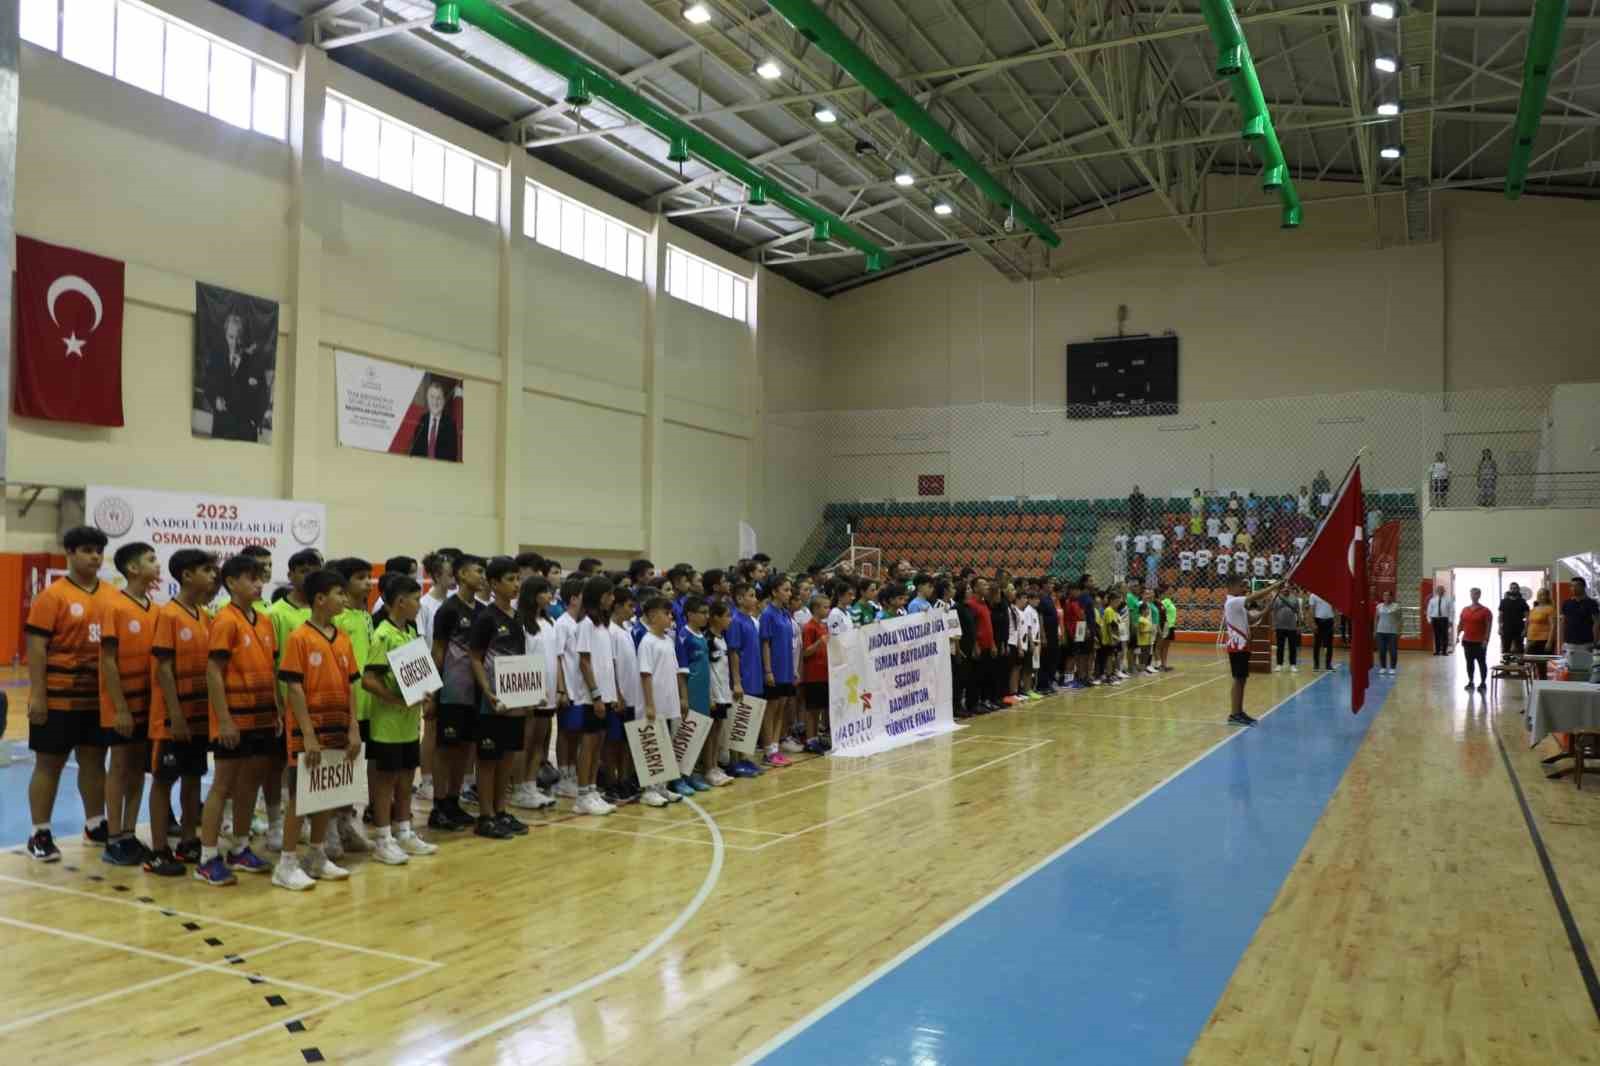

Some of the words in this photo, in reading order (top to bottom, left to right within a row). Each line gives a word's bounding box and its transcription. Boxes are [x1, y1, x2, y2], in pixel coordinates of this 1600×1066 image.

[196, 503, 239, 520] 2023
[144, 517, 201, 531] ANADOLU
[152, 531, 202, 546] OSMAN
[205, 533, 277, 548] BAYRAKDAR
[399, 655, 433, 688] GİRESUN
[499, 671, 542, 694] KARAMAN
[895, 668, 921, 689] SEZONU
[729, 702, 753, 743] ANKARA
[637, 724, 665, 777] SAKARYA
[309, 762, 354, 793] MERSİN
